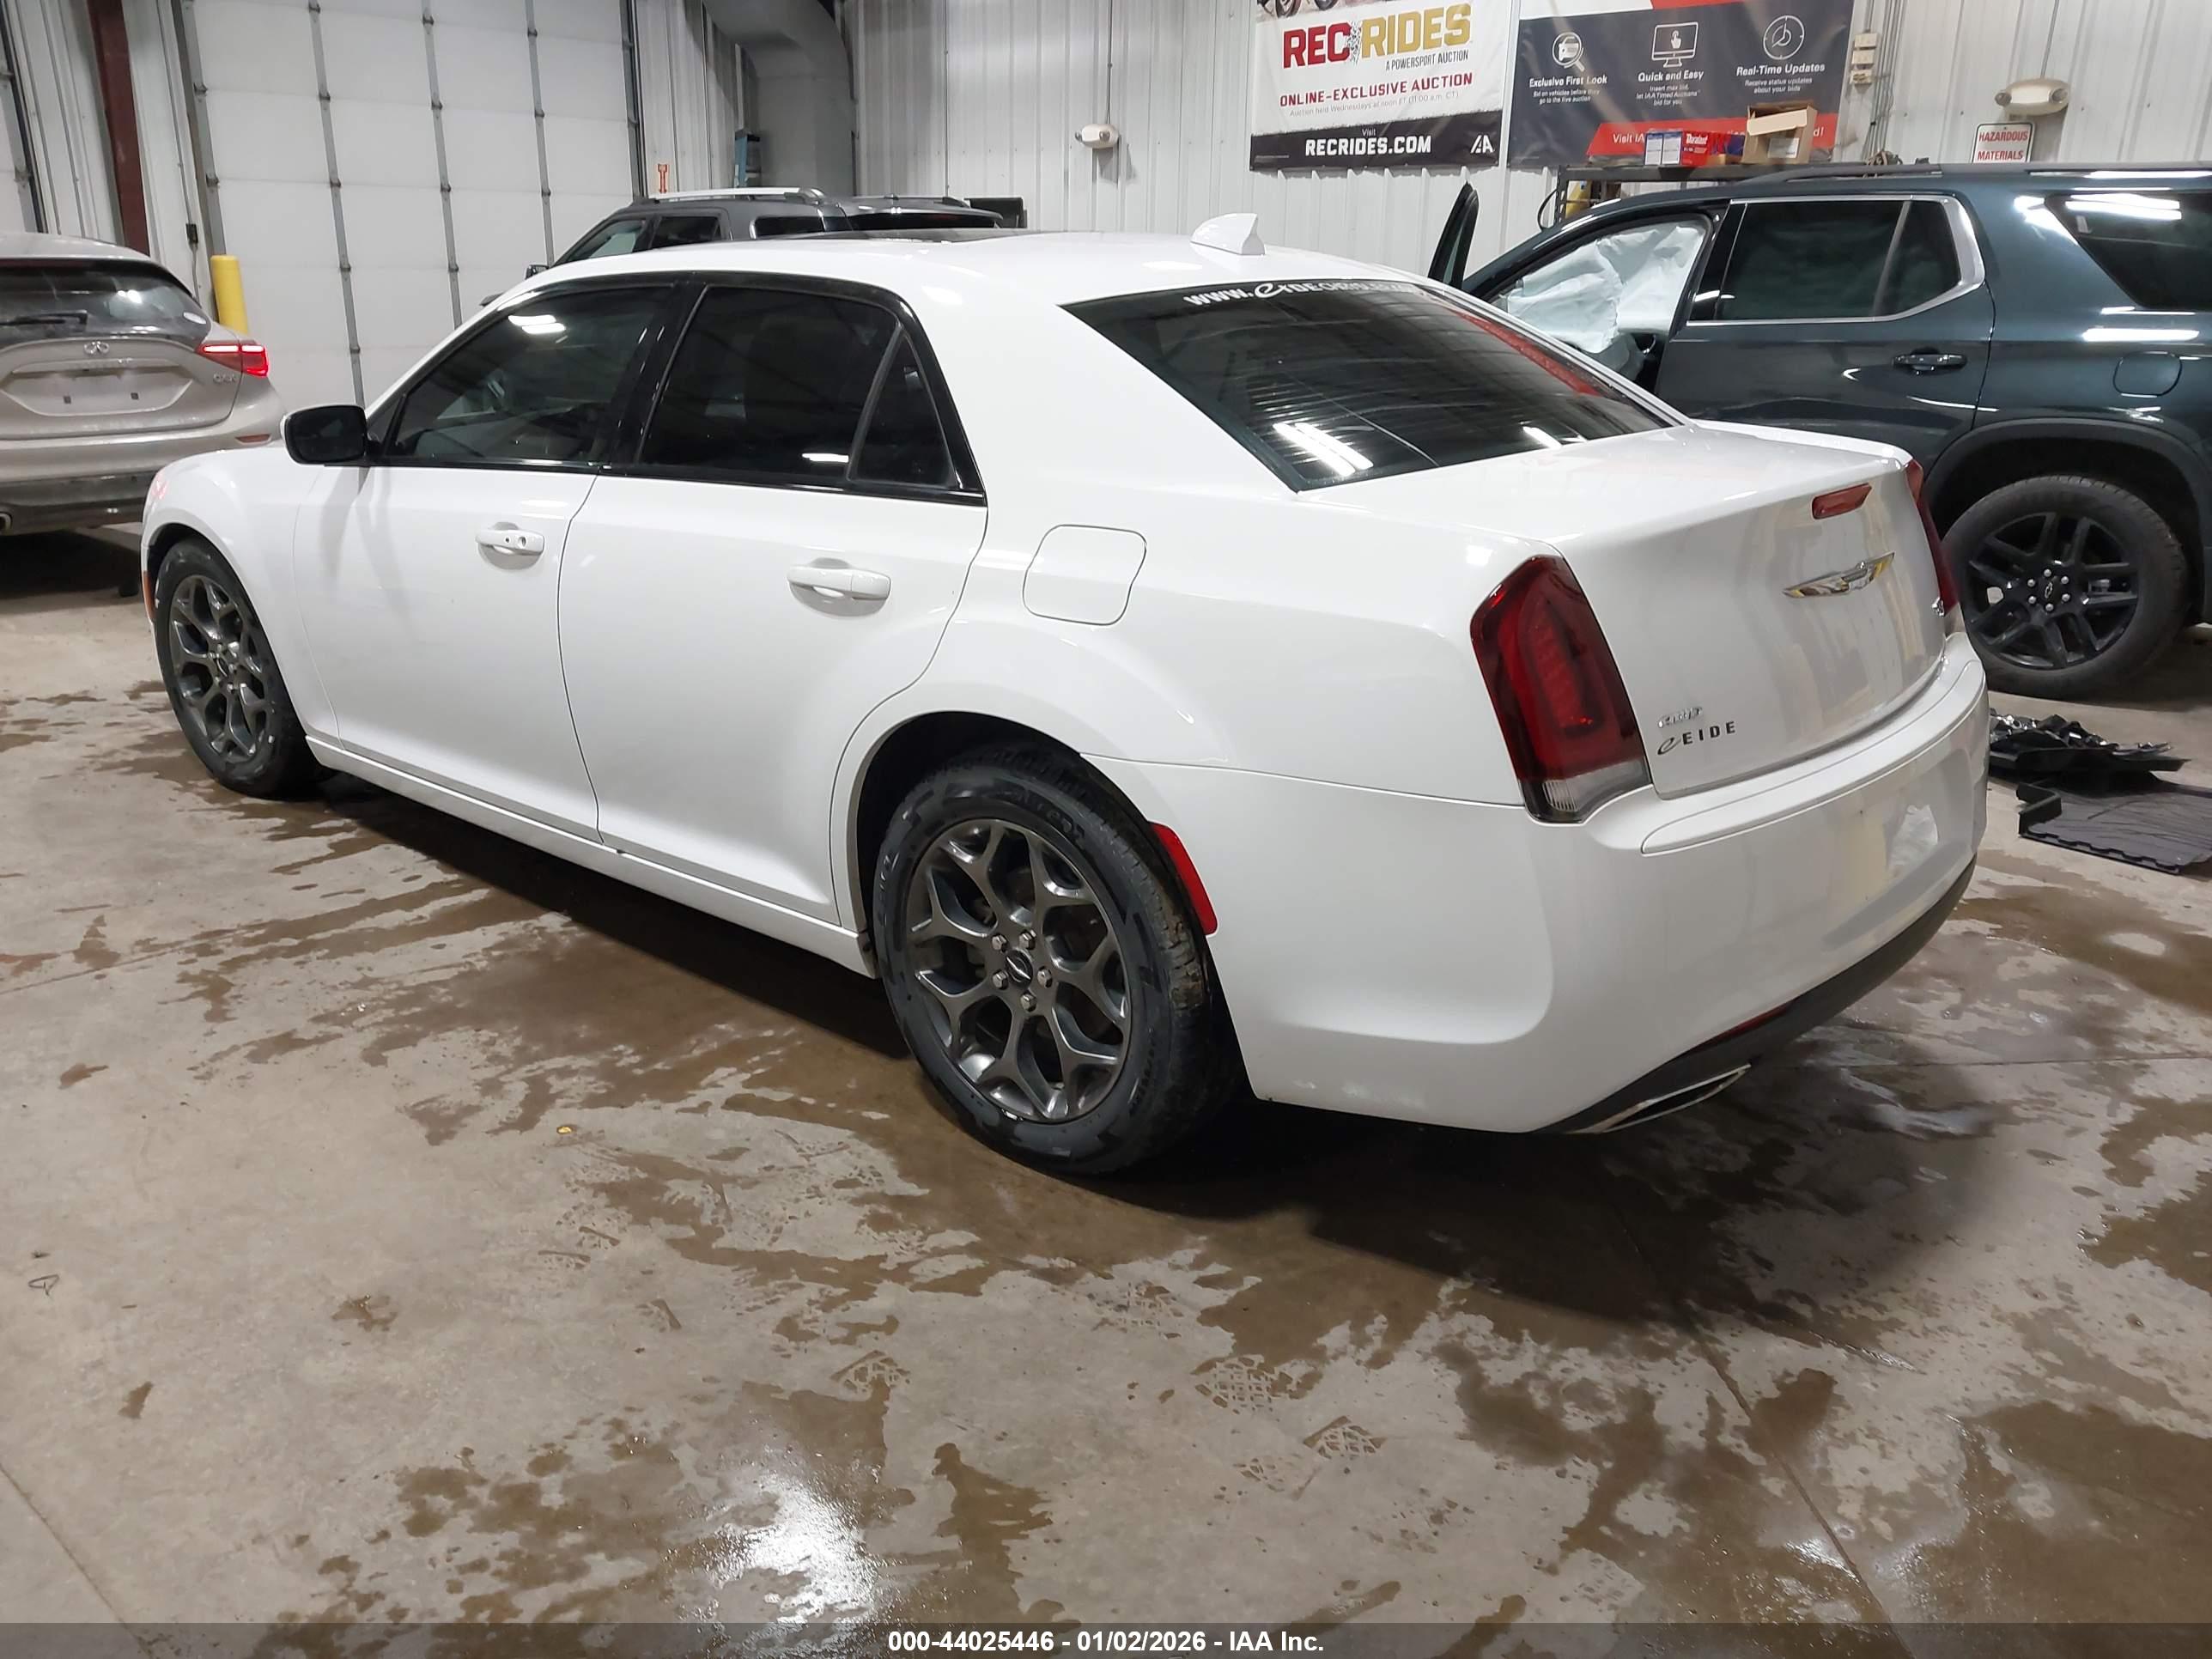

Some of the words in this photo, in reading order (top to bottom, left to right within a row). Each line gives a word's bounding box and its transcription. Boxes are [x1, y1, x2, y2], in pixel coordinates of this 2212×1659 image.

[1283, 21, 1352, 69] REC
[1361, 3, 1472, 59] RIDES
[1385, 60, 1390, 70] A
[1391, 53, 1436, 70] POWERSPORT
[1437, 50, 1469, 64] AUCTION
[1736, 64, 1783, 76] Real-Time
[1784, 63, 1826, 76] Updates
[1529, 76, 1565, 88] Exclusive
[1565, 76, 1584, 85] First
[1586, 74, 1607, 84] Look
[1638, 71, 1664, 82] Quick
[1666, 70, 1681, 81] and
[1683, 70, 1704, 80] Easy
[1788, 77, 1813, 86] updates
[1280, 81, 1407, 107] ONLINE-EXCLUSIVE
[1412, 72, 1473, 92] AUCTION
[1362, 128, 1376, 137] Visit
[1613, 133, 1632, 143] Visit
[1634, 133, 1645, 143] IA
[1978, 131, 2028, 142] HAZARDOUS
[1304, 135, 1431, 157] RECRIDES.COM
[1978, 150, 2024, 161] MATERIALS
